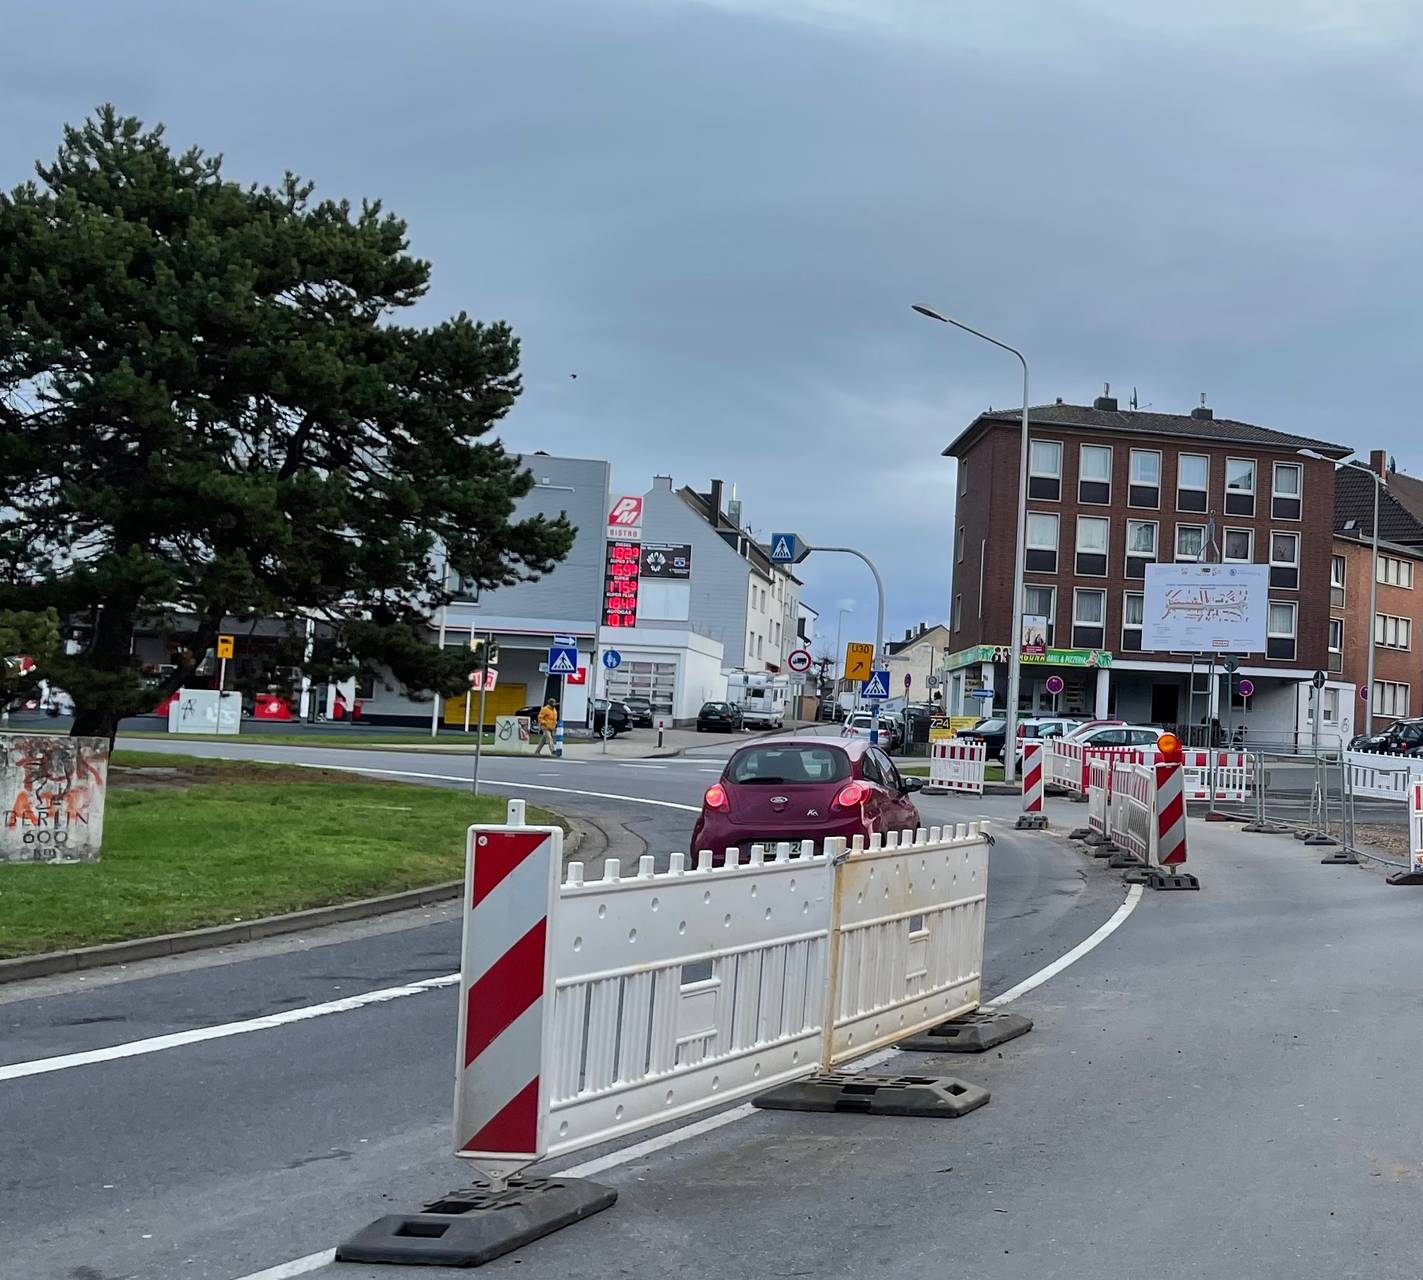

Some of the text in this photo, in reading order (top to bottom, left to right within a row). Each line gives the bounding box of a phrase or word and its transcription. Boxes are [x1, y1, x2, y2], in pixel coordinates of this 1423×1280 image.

[609, 529, 638, 538] BISTRO
[851, 645, 870, 654] U30
[4, 809, 90, 828] BERLIN
[22, 829, 68, 844] 600
